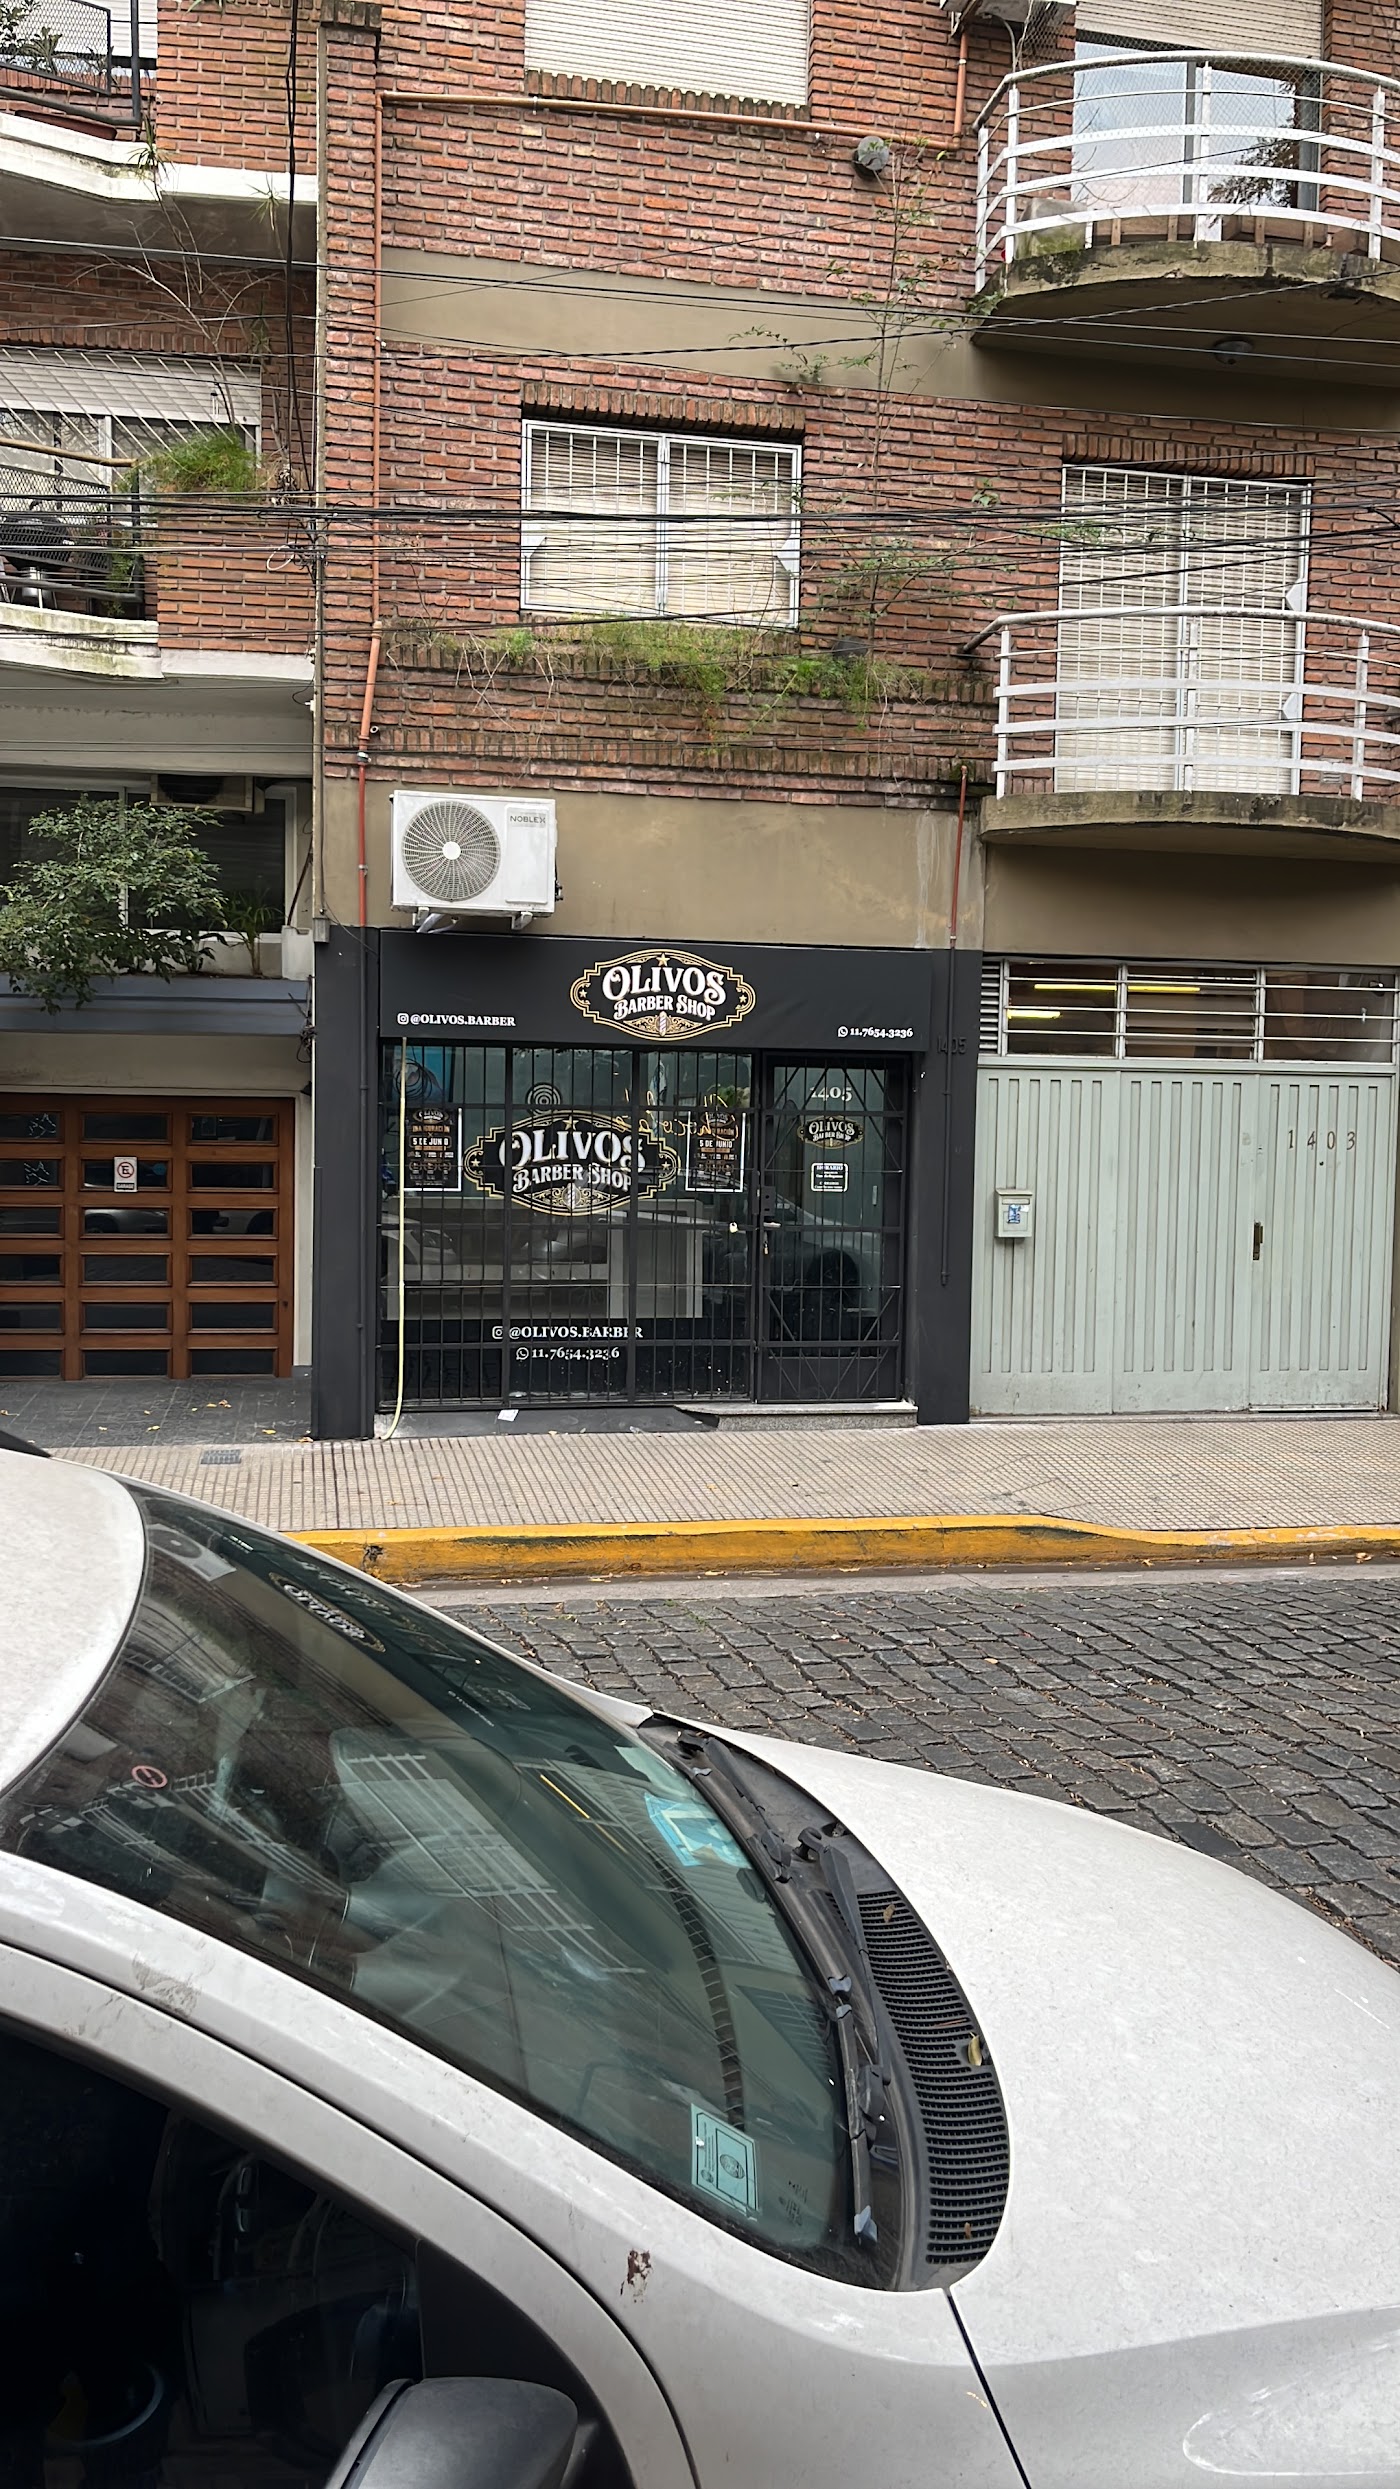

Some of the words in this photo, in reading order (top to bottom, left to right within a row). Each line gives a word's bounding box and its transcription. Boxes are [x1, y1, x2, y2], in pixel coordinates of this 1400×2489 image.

[509, 815, 546, 824] NOBLEX
[602, 965, 727, 1006] OLIVOS
[613, 995, 674, 1021] BARBER
[676, 994, 716, 1021] SHOP
[410, 1014, 516, 1027] @OLIVOS.BARBER
[849, 1026, 914, 1039] 11.7654.3236
[808, 1121, 855, 1136] OLIVOS
[428, 1137, 449, 1146] JUNO
[1288, 1129, 1355, 1150] 1403
[499, 1129, 646, 1173] OLIVOS
[512, 1163, 584, 1193] BARBER
